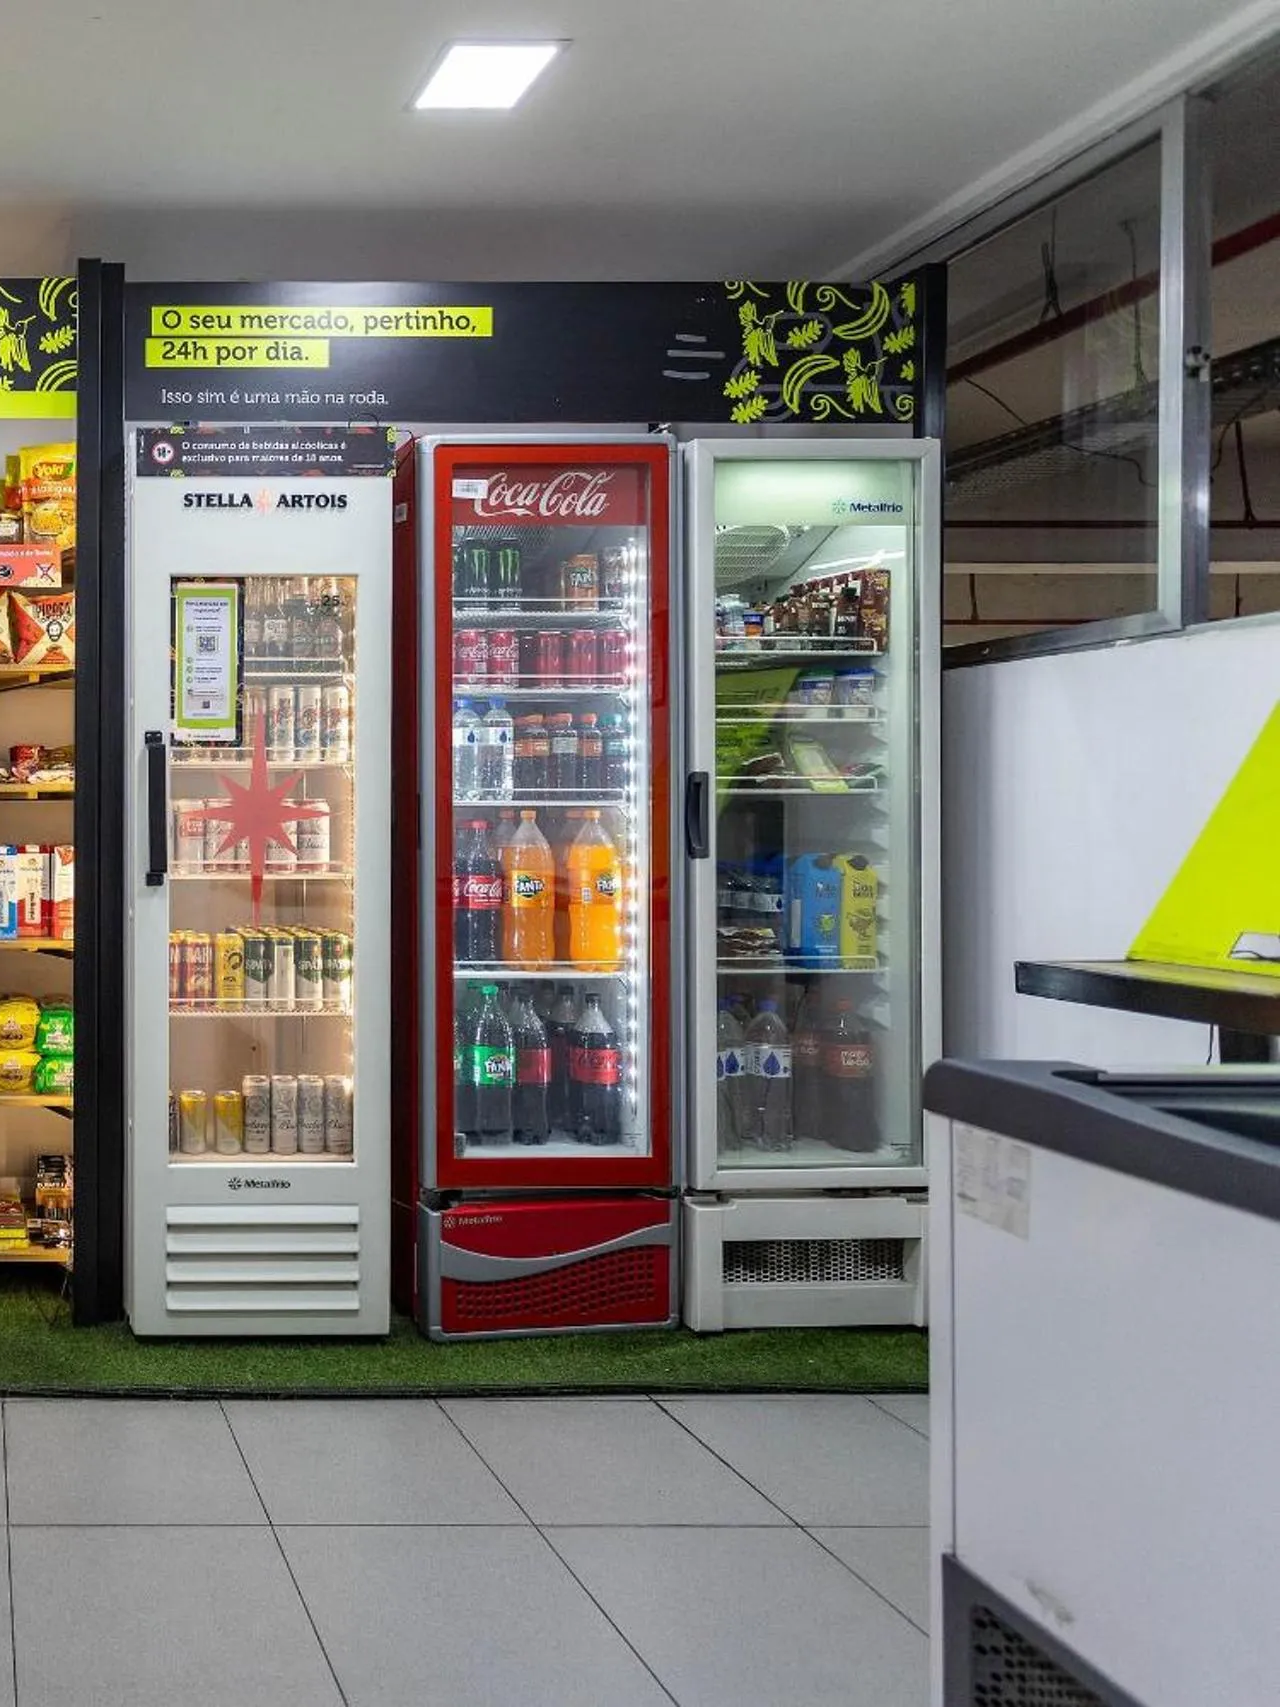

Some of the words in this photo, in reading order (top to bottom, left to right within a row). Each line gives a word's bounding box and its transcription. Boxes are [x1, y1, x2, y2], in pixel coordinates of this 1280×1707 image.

[162, 309, 181, 329] O
[189, 313, 232, 329] seu
[240, 309, 355, 333] mercado,
[364, 309, 478, 335] pertinho,
[162, 341, 208, 361] 24h
[216, 343, 258, 367] por
[266, 341, 309, 361] dia.
[162, 389, 193, 404] Isso
[197, 390, 227, 404] sim
[230, 390, 240, 404] é
[244, 393, 280, 404] uma
[285, 391, 320, 404] mão
[325, 394, 345, 404] na
[349, 391, 389, 405] roda.
[192, 442, 237, 450] consumo
[240, 441, 250, 450] de
[252, 441, 289, 450] bebidas
[182, 453, 227, 462] exclusivo
[228, 454, 250, 464] para
[252, 453, 289, 462] maiores
[291, 453, 303, 462] de
[184, 493, 253, 508] STELLA
[276, 493, 348, 508] ARTOIS
[475, 472, 616, 518] Coca-Cola
[849, 502, 903, 513] Metalfrio
[244, 1179, 291, 1189] Metalfrio
